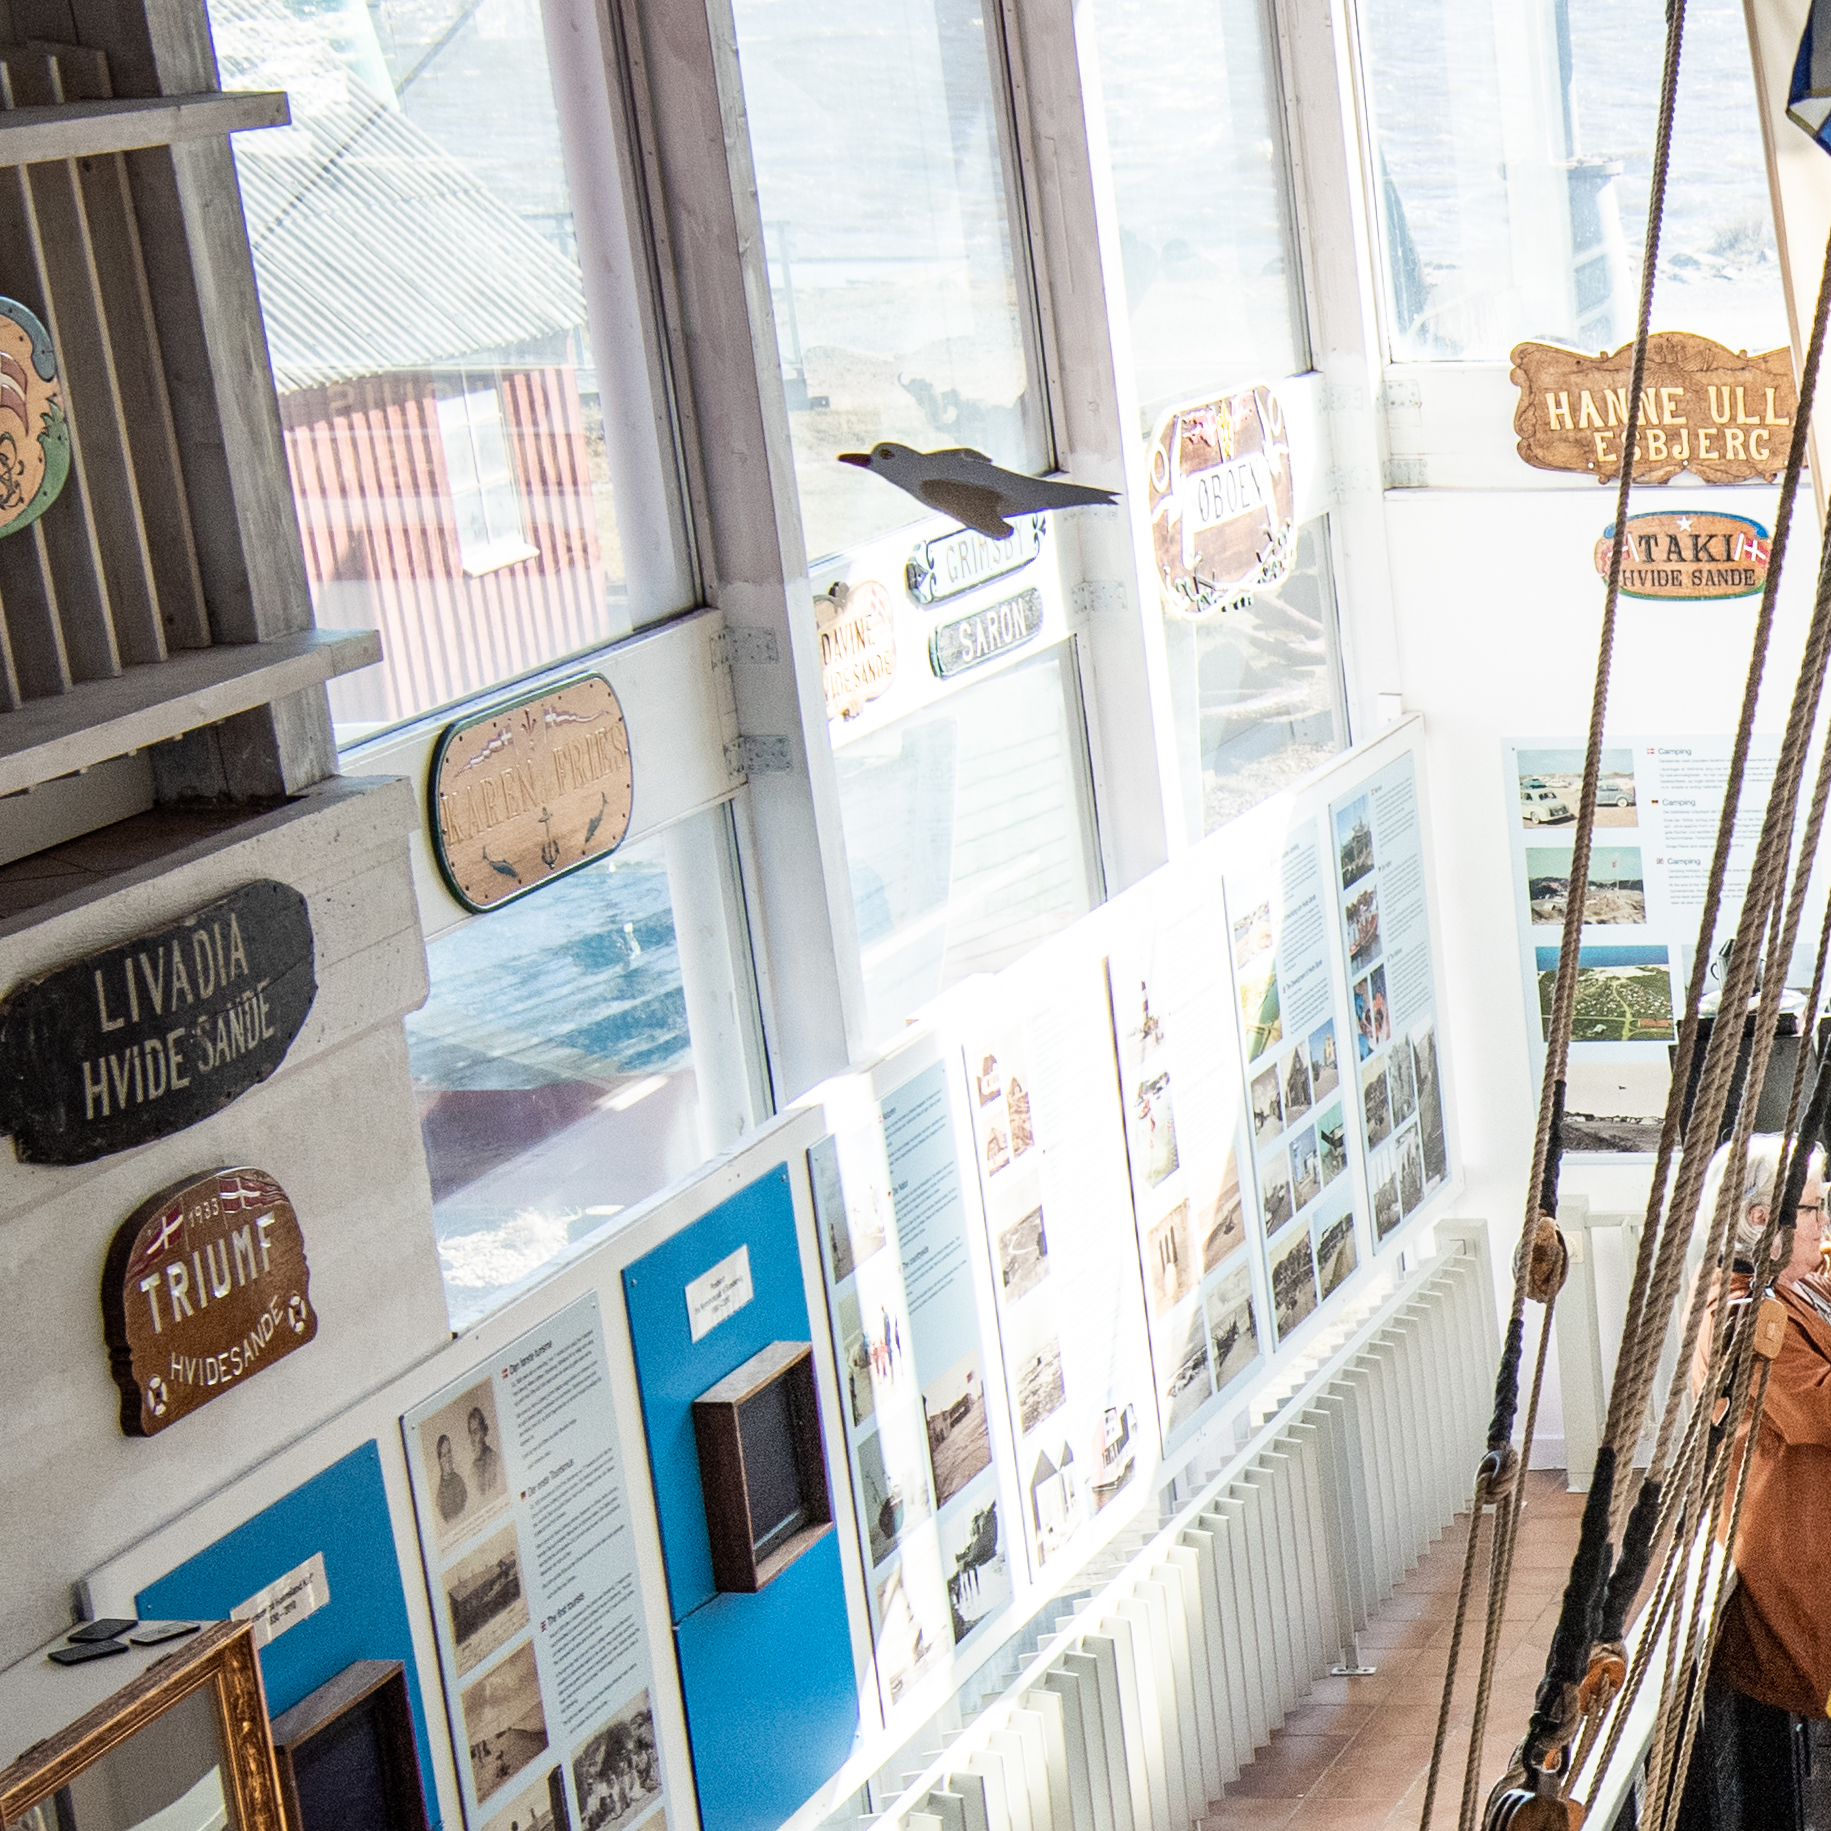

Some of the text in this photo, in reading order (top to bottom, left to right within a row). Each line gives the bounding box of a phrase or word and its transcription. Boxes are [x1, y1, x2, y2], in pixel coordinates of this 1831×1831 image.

[1545, 387, 1687, 431] HANNE
[1592, 428, 1771, 463] ESBJERG
[945, 520, 1026, 584] GRIMSBY
[1638, 533, 1736, 563] TAKI
[1622, 568, 1756, 588] HVIDE SANDE
[958, 598, 1029, 663] SARON
[1657, 747, 1692, 757] Camping
[1661, 798, 1696, 808] Camping
[1667, 857, 1701, 867] Camping
[95, 912, 250, 1035] LIVADIA
[83, 977, 276, 1120] HVIDE SANDE
[187, 1196, 220, 1229] 1933
[141, 1212, 276, 1334] TRIUMF
